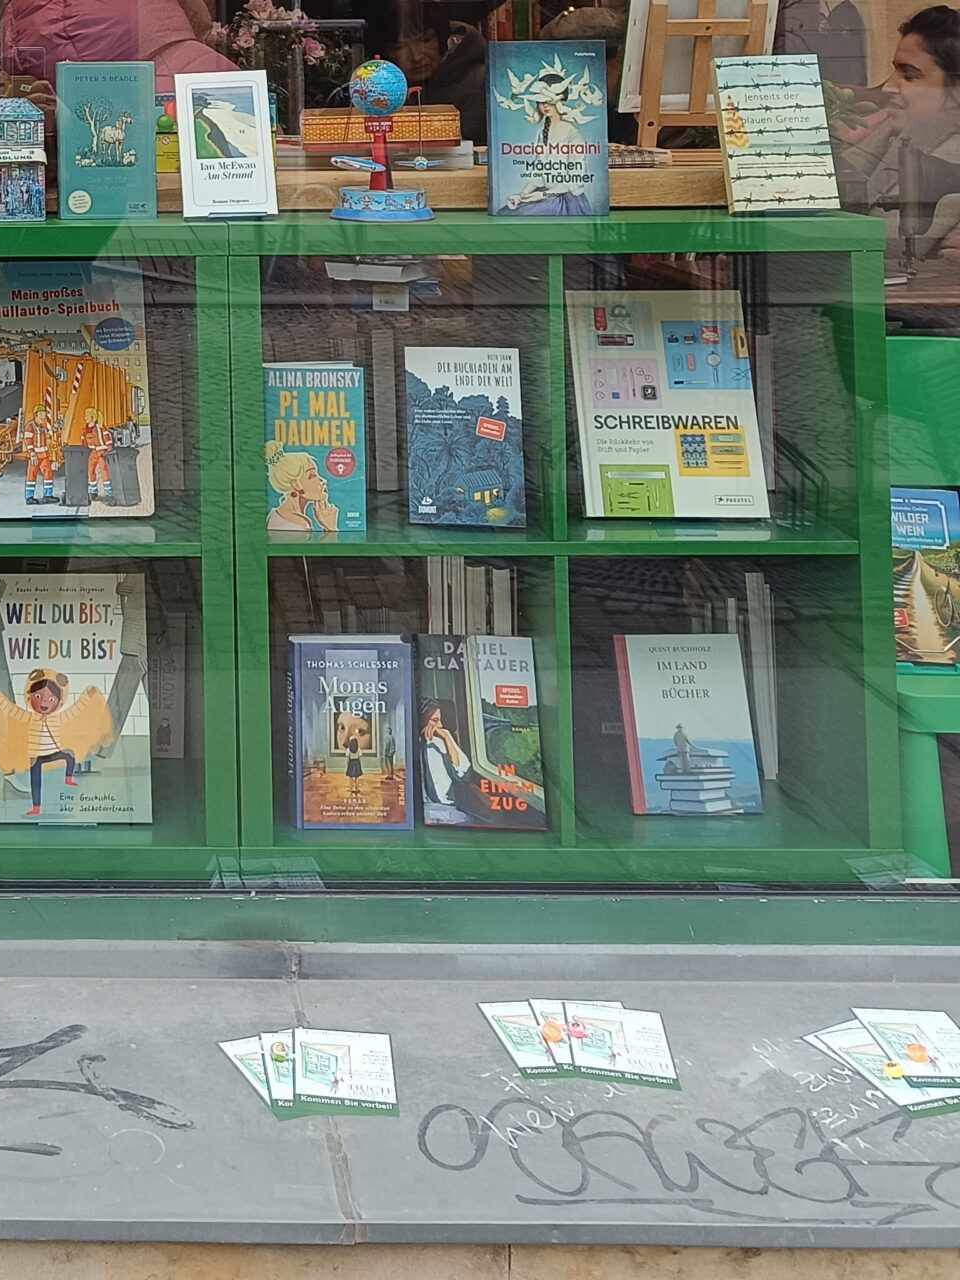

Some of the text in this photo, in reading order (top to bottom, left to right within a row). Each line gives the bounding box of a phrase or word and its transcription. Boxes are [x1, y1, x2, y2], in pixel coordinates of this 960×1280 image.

[744, 92, 799, 102] Jenseits der
[775, 114, 810, 123] Grenze
[501, 141, 601, 155] Dacia Maraini
[200, 162, 256, 171] Ian McEwan
[525, 159, 583, 171] Mädchen
[204, 171, 253, 180] Am Strand
[544, 172, 595, 184] Träumer
[11, 287, 83, 301] Mein großes
[57, 300, 120, 316] Spielbuch
[437, 362, 513, 374] DER BUCHLADEN AM
[268, 371, 360, 388] ALINA BRONSKY
[456, 375, 513, 387] ENDE DER WELT
[309, 391, 350, 418] MAL
[593, 414, 739, 430] SCHREIBWAREN
[274, 419, 357, 448] DAUMEN
[895, 524, 925, 537] WEIN
[52, 603, 74, 624] DU
[48, 639, 72, 660] DU
[443, 641, 507, 655] DAIEL
[307, 660, 399, 669] THOMAS SCHLESSER
[423, 656, 529, 673] GLAAUER
[656, 661, 707, 671] IM LAND
[318, 676, 388, 695] Monas
[672, 675, 696, 686] DER
[661, 687, 710, 700] BÜCHER
[322, 697, 387, 718] Augen
[497, 764, 516, 776] IN
[480, 778, 535, 794] EINEM
[491, 795, 528, 811] ZUG
[580, 1067, 674, 1085] Kommen Sie vorbei!
